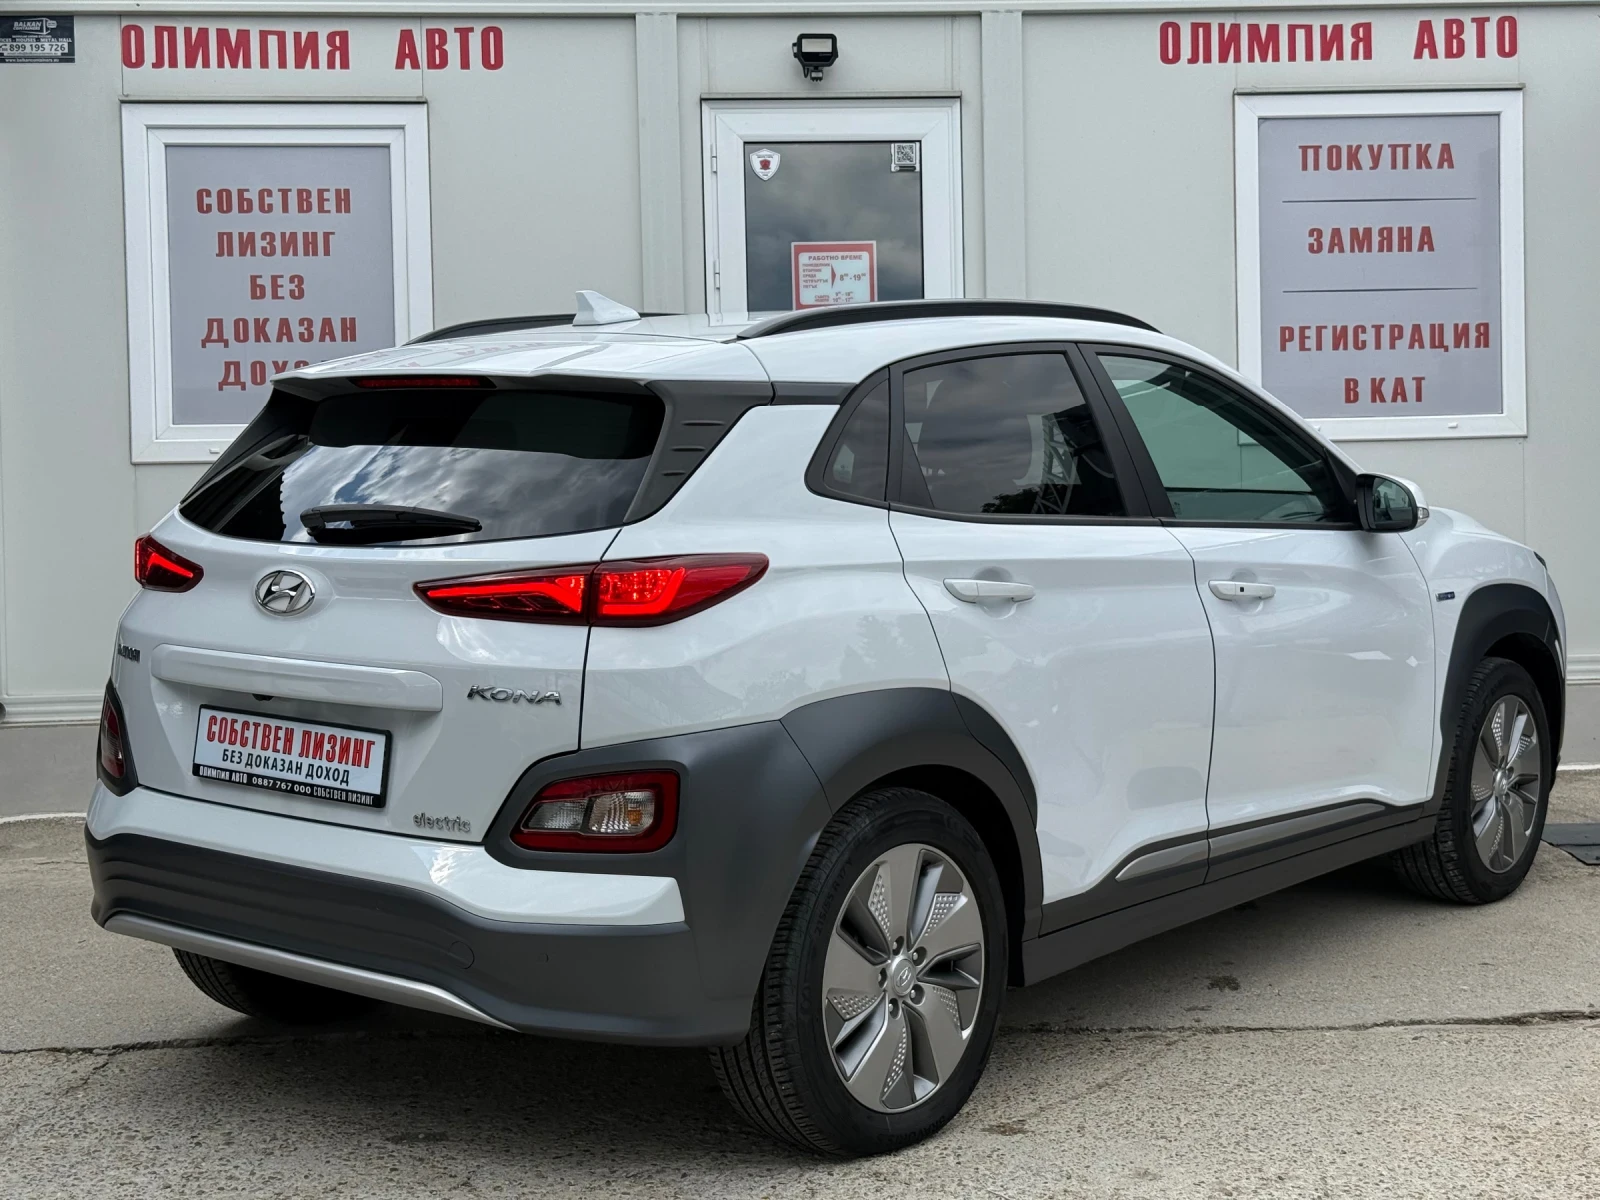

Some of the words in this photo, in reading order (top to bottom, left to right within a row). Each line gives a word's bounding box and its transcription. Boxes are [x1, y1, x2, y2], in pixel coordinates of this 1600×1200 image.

[9, 44, 26, 52] 899
[30, 44, 46, 52] 195
[48, 44, 66, 52] 726
[121, 24, 350, 71] ОЛИМПИЯ
[395, 26, 505, 71] АВТО
[1159, 21, 1373, 65] ОЛИМПИЯ
[1413, 15, 1519, 60] АВТО
[1298, 143, 1454, 171] ПОКУПКА
[197, 188, 351, 214] СОБСТВЕН
[216, 231, 335, 257] ЛИЗИНГ
[1308, 226, 1435, 254] ЗАМЯНА
[250, 275, 305, 300] БЕЗ
[201, 317, 357, 348] ДОКАЗАН
[1280, 322, 1490, 352] РЕГИСТРАЦИЯ
[218, 360, 312, 392] ДОХ
[1344, 378, 1359, 404] В
[1370, 377, 1427, 404] КАТ
[466, 684, 562, 705] KONA
[206, 714, 295, 756] СОБСТВЕН
[298, 729, 376, 769] ЛИЗИНГ
[222, 748, 243, 765] БЕЗ
[244, 752, 303, 776] ДОКАЗАН
[304, 763, 350, 787] ДОХОД
[199, 765, 230, 781] ОЛИМПИЯ
[231, 771, 248, 784] АВТО
[252, 776, 274, 787] 0887
[275, 780, 292, 791] 767
[293, 784, 312, 794] 000
[313, 786, 346, 801] СОБСТВЕН
[347, 791, 375, 806] ЛИЗИНГ
[412, 812, 471, 833] electric
